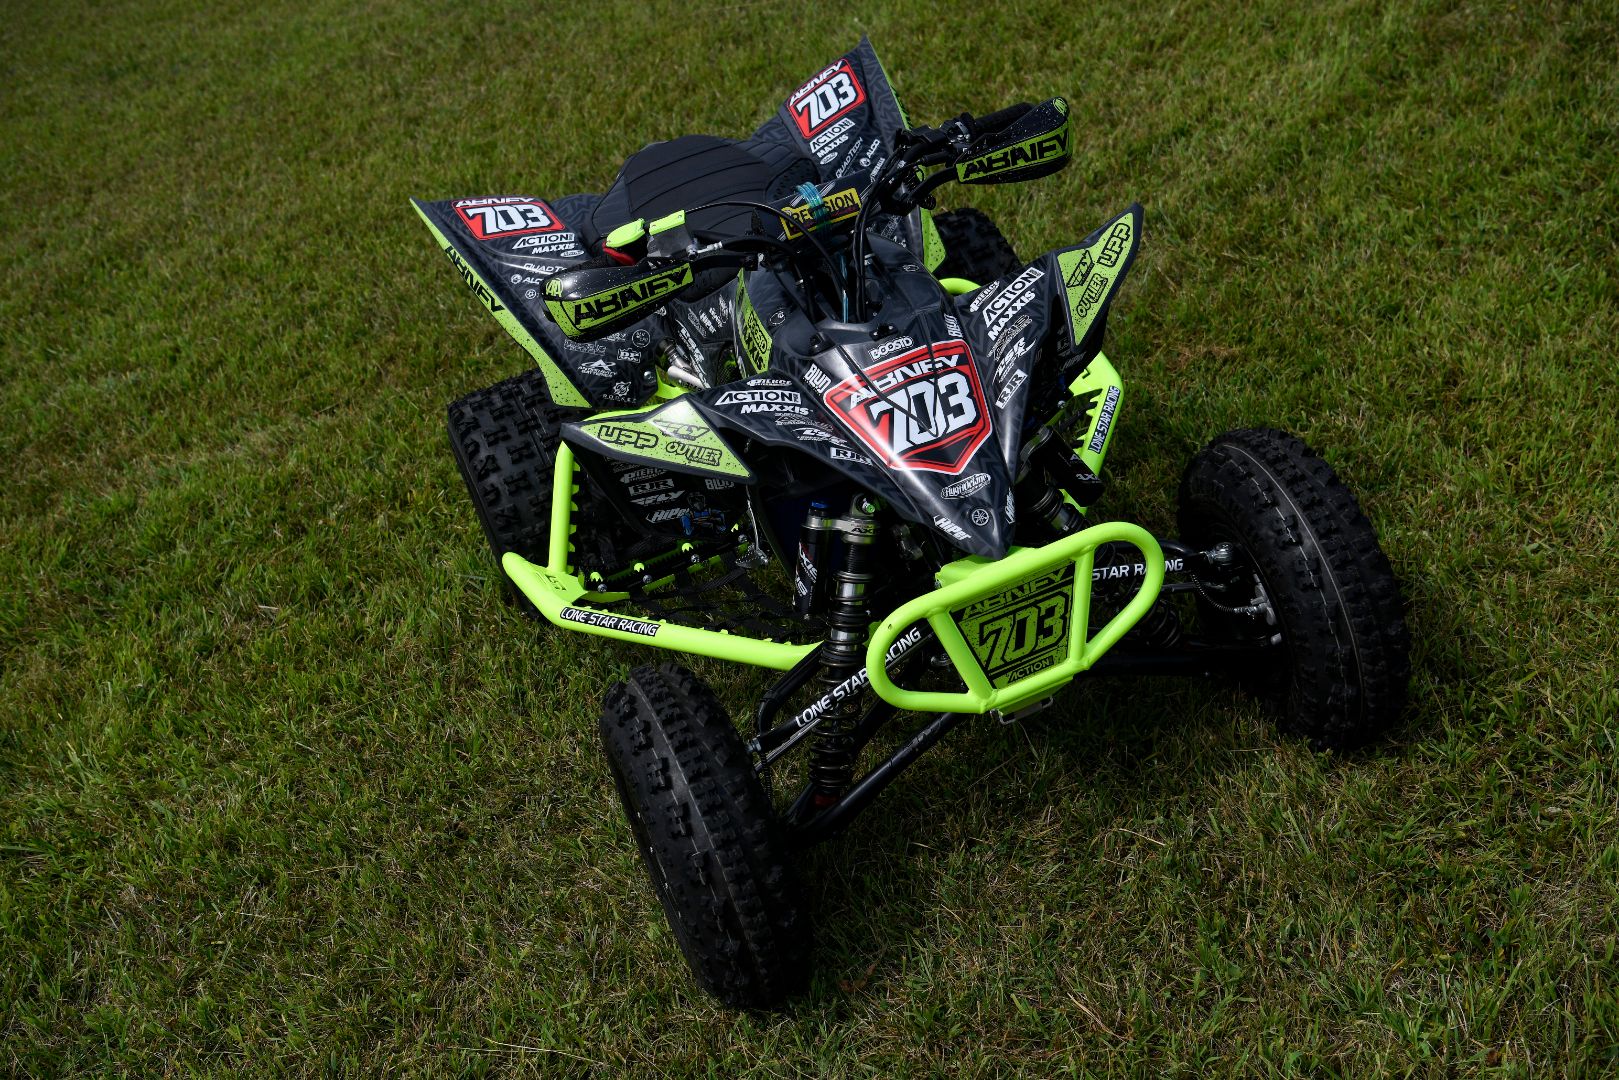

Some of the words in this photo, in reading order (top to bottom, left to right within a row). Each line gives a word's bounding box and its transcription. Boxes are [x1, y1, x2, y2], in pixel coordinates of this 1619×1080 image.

[790, 60, 843, 106] ABNEY
[796, 72, 856, 129] 703
[811, 121, 850, 151] ACTION
[817, 134, 849, 158] MAXXIS
[866, 139, 880, 159] ALCO
[963, 130, 1069, 180] ABNEY
[456, 198, 534, 207] ABNEY
[466, 204, 551, 234] 703
[516, 233, 569, 247] ACTION
[532, 243, 575, 254] MAXXIS
[445, 246, 505, 313] ABNEY
[574, 267, 692, 326] ABNEY
[985, 273, 1037, 322] ACTION
[1076, 273, 1106, 317] OUTLIER
[988, 290, 1035, 341] MAXXIS
[719, 392, 793, 402] ACTION
[850, 354, 960, 410] ABNEY
[996, 370, 1028, 409] RJR
[741, 404, 809, 415] MAXXIS
[869, 372, 977, 454] 703
[1103, 386, 1120, 413] RACING
[1097, 411, 1113, 433] STAR
[666, 441, 722, 466] OUTLIER
[1089, 431, 1106, 453] LONE
[1092, 567, 1129, 580] STAR
[1134, 559, 1184, 576] RNG
[962, 566, 1067, 619] ABNEY
[561, 608, 589, 622] LONE
[588, 614, 618, 629] STAR
[618, 619, 659, 635] RACING
[981, 592, 1068, 671] 703
[796, 695, 832, 727] LONE
[833, 667, 868, 701] STAR
[885, 627, 921, 665] ACING
[1009, 658, 1050, 681] ACTION
